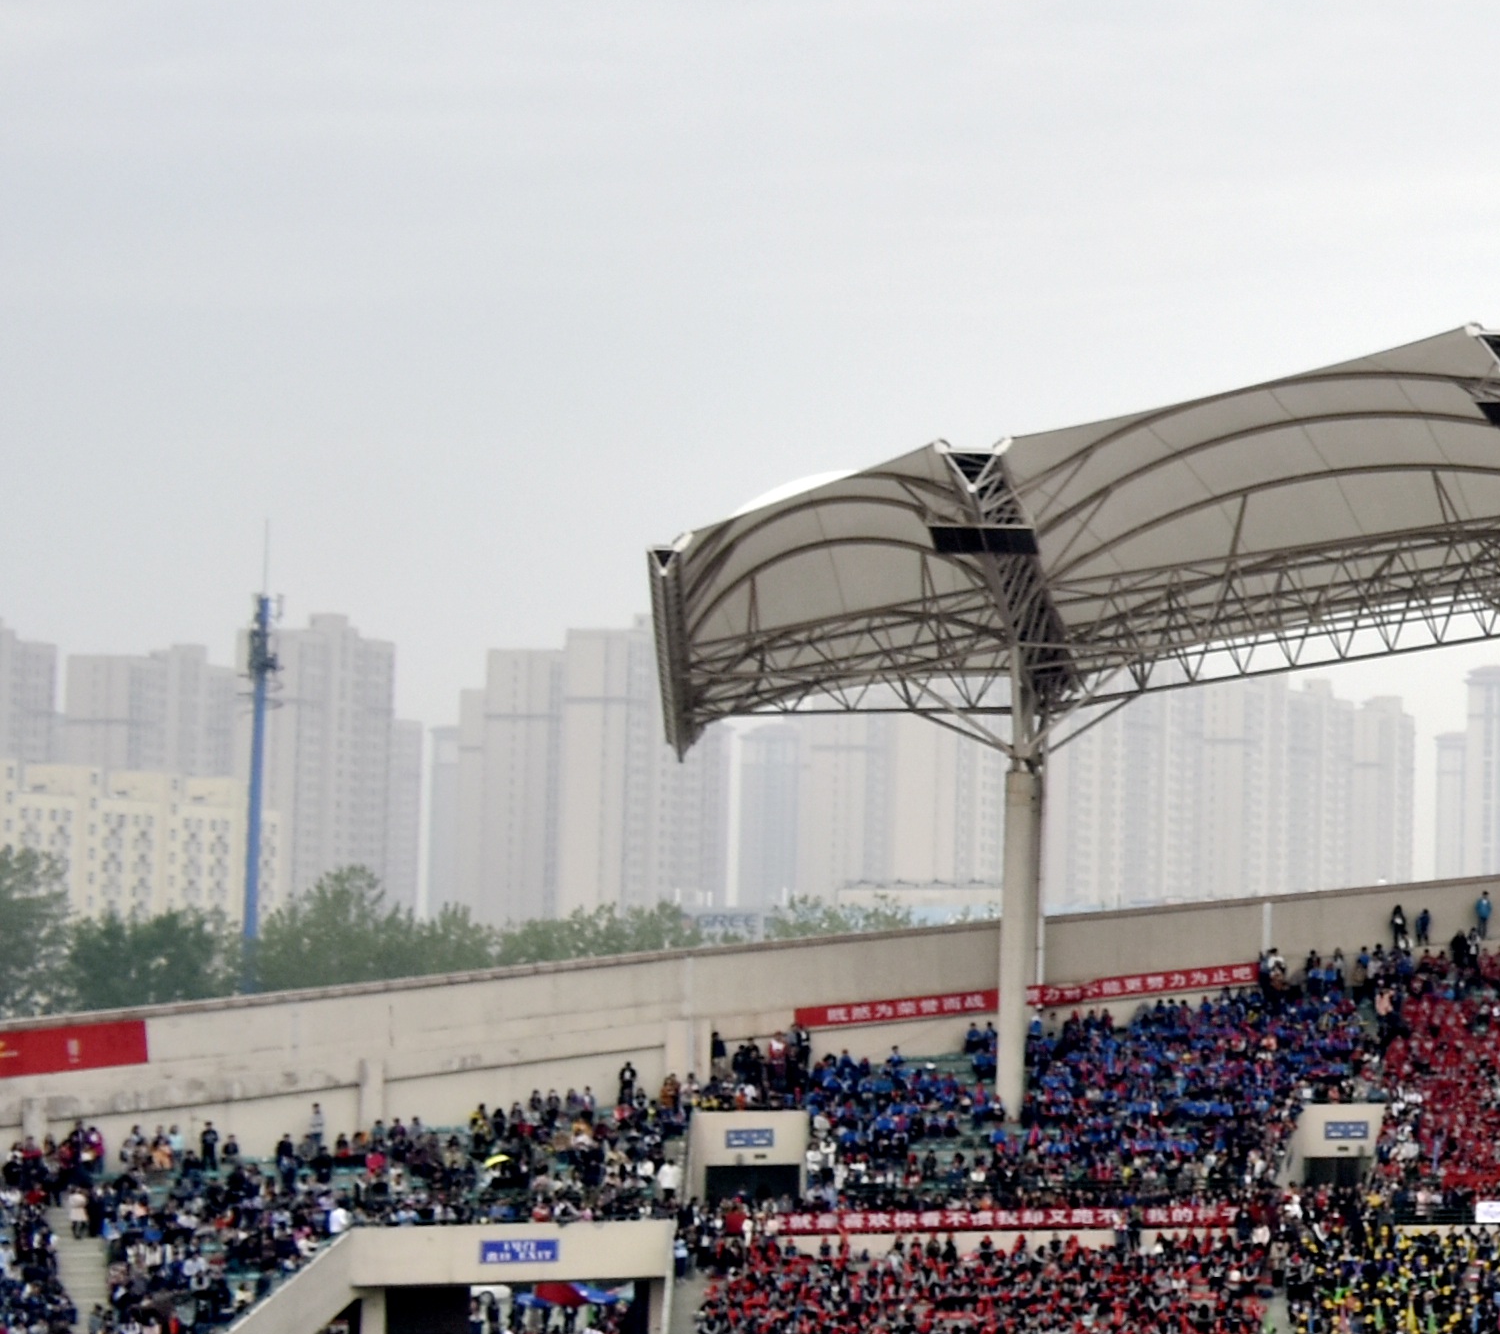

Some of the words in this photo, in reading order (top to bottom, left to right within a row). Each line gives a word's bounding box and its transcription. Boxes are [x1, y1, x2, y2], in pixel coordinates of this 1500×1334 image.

[826, 993, 986, 1023] 既然为荣誉而战
